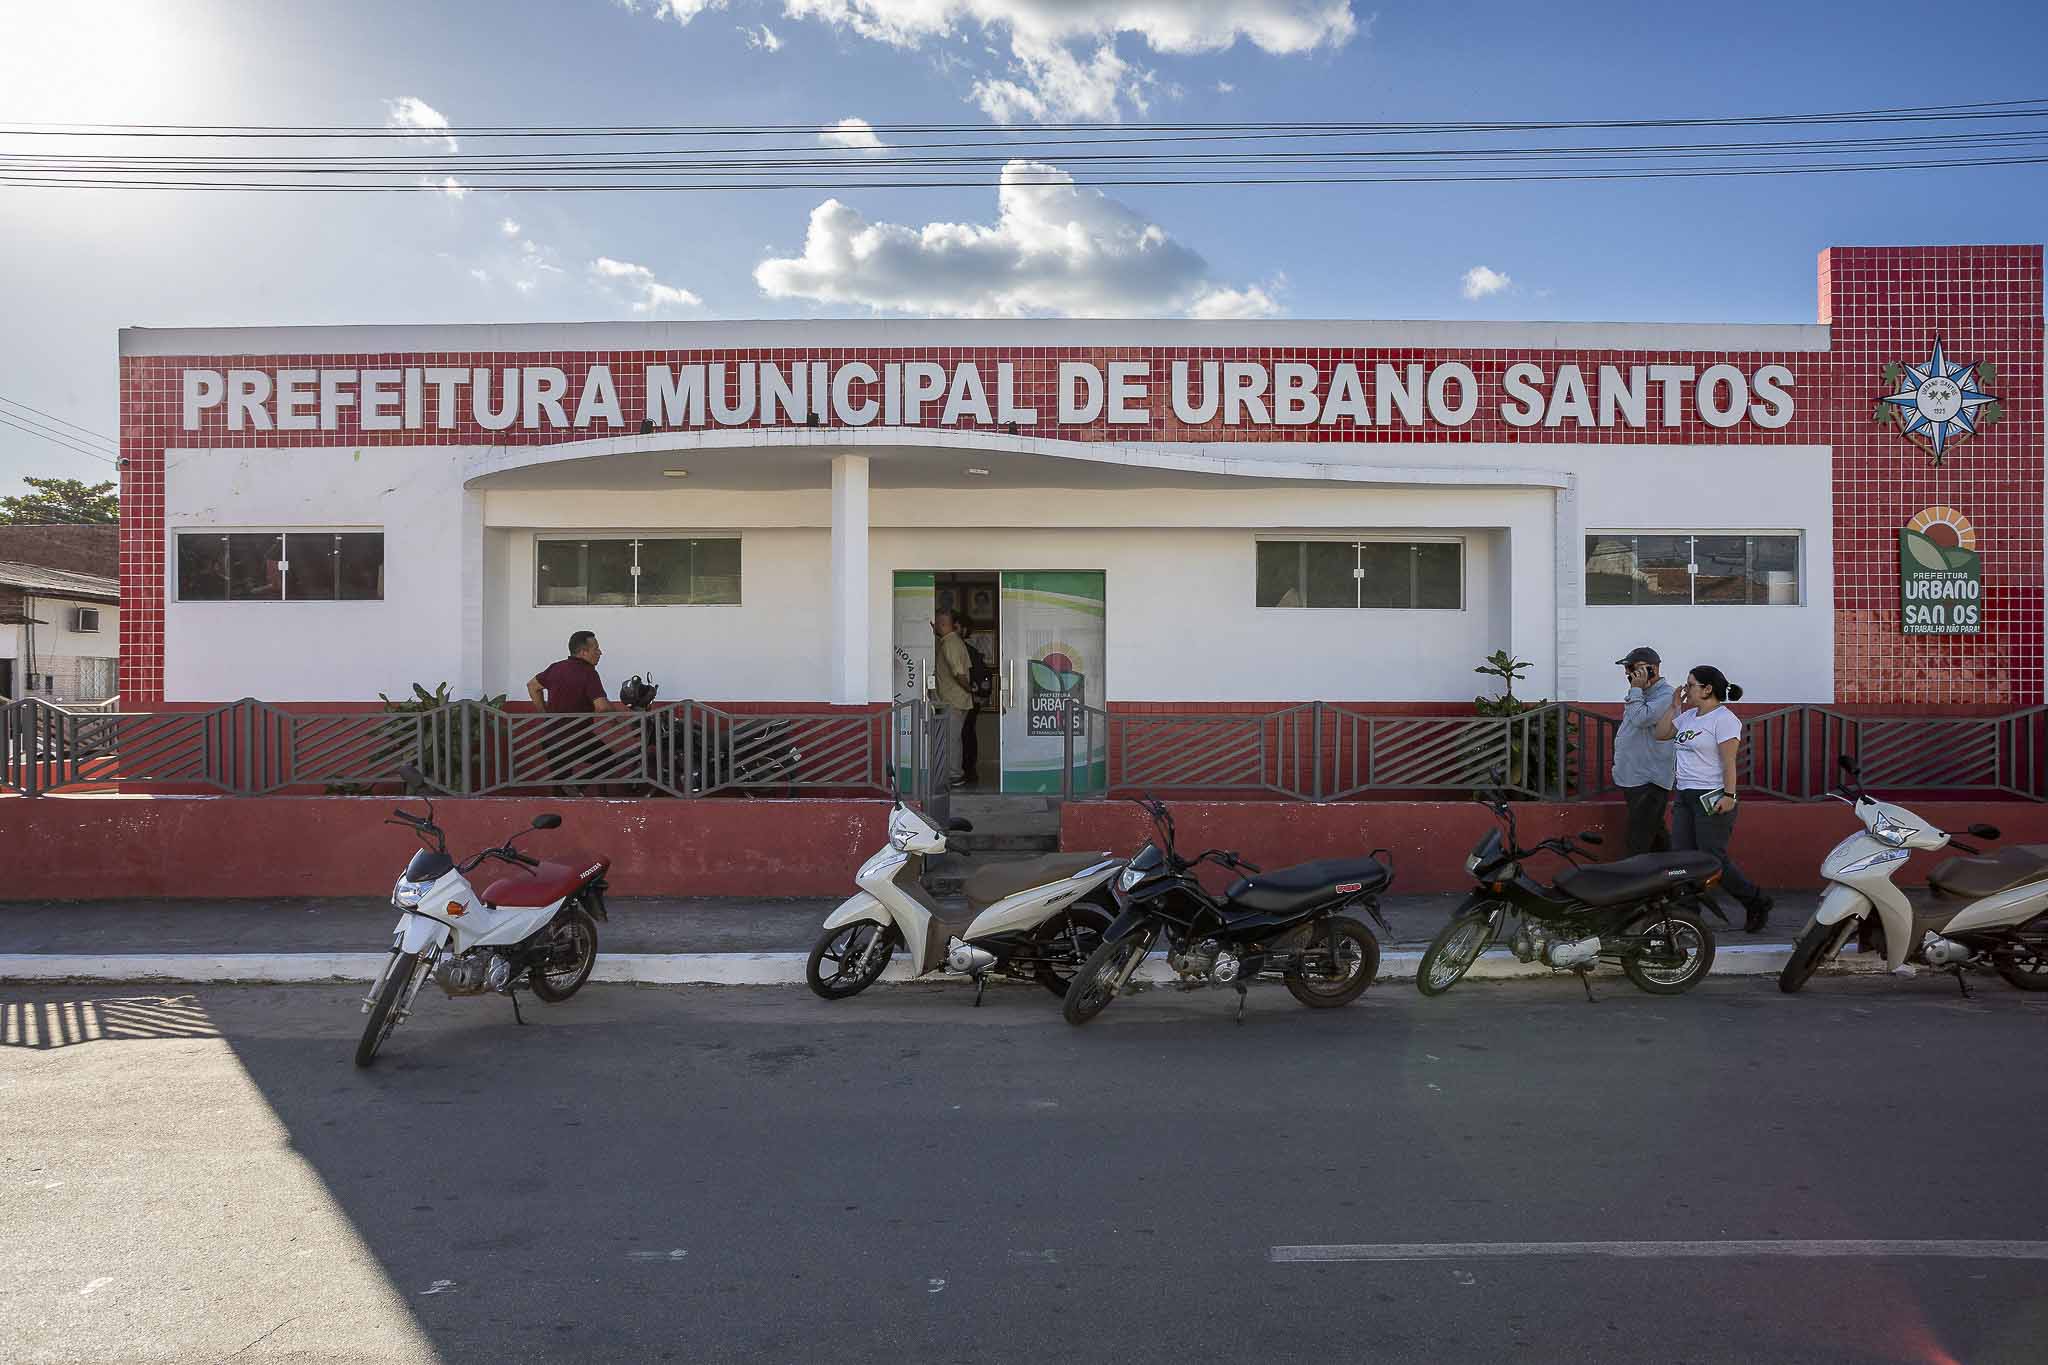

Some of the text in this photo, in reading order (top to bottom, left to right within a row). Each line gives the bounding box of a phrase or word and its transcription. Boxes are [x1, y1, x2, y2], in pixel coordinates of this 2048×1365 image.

[182, 360, 1795, 432] PREFEITURA MUNICIPAL DE URBANO SANTOS
[1905, 580, 1979, 599] URBANO
[1905, 604, 1978, 625] SANOS
[1903, 623, 1980, 633] O TRABALHO NÃO PARA!
[894, 646, 915, 688] ROVADO
[1032, 715, 1080, 729] SANS
[579, 862, 602, 879] HONDA
